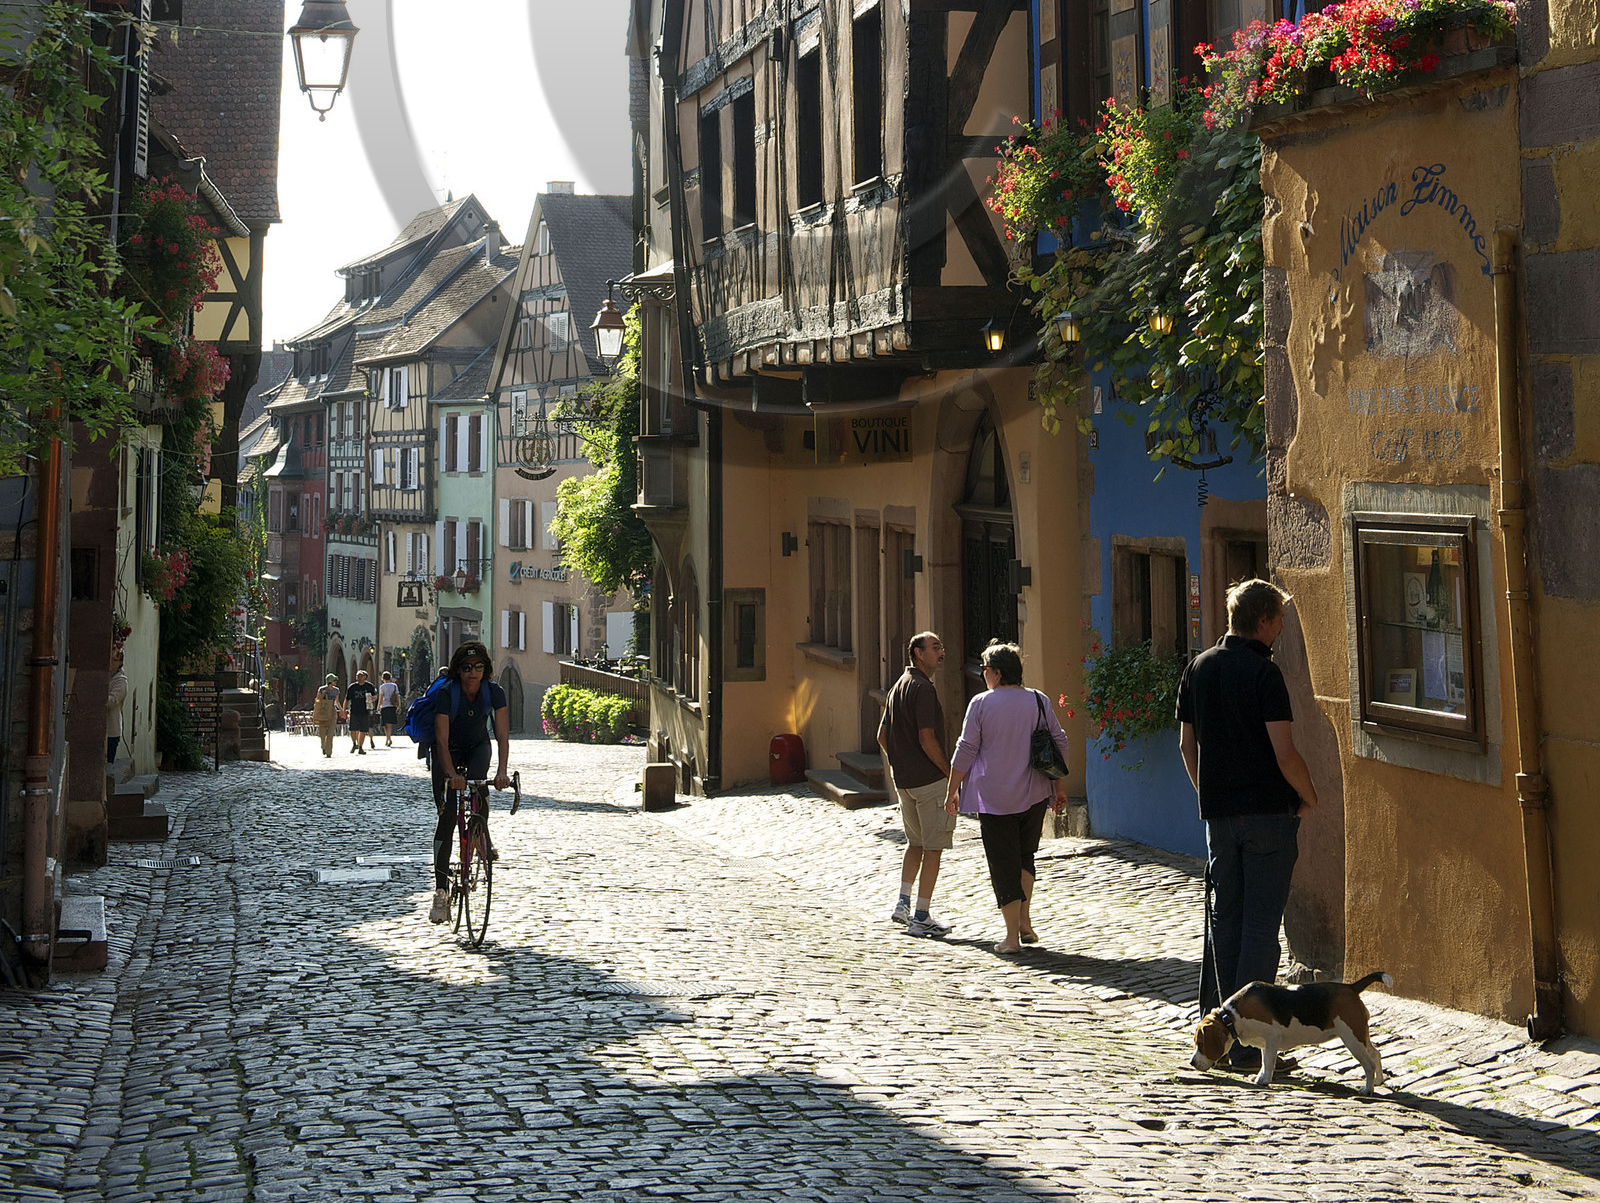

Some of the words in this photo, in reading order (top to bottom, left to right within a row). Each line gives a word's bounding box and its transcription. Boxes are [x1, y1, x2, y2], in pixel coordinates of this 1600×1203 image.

[1328, 181, 1399, 303] Maison
[1347, 389, 1376, 415] VINS
[1380, 386, 1410, 414] FINS
[1414, 383, 1480, 414] D'ALSACE
[851, 416, 908, 428] BOUTIQUE
[852, 429, 909, 454] VINI
[540, 569, 566, 582] AGRICOLE
